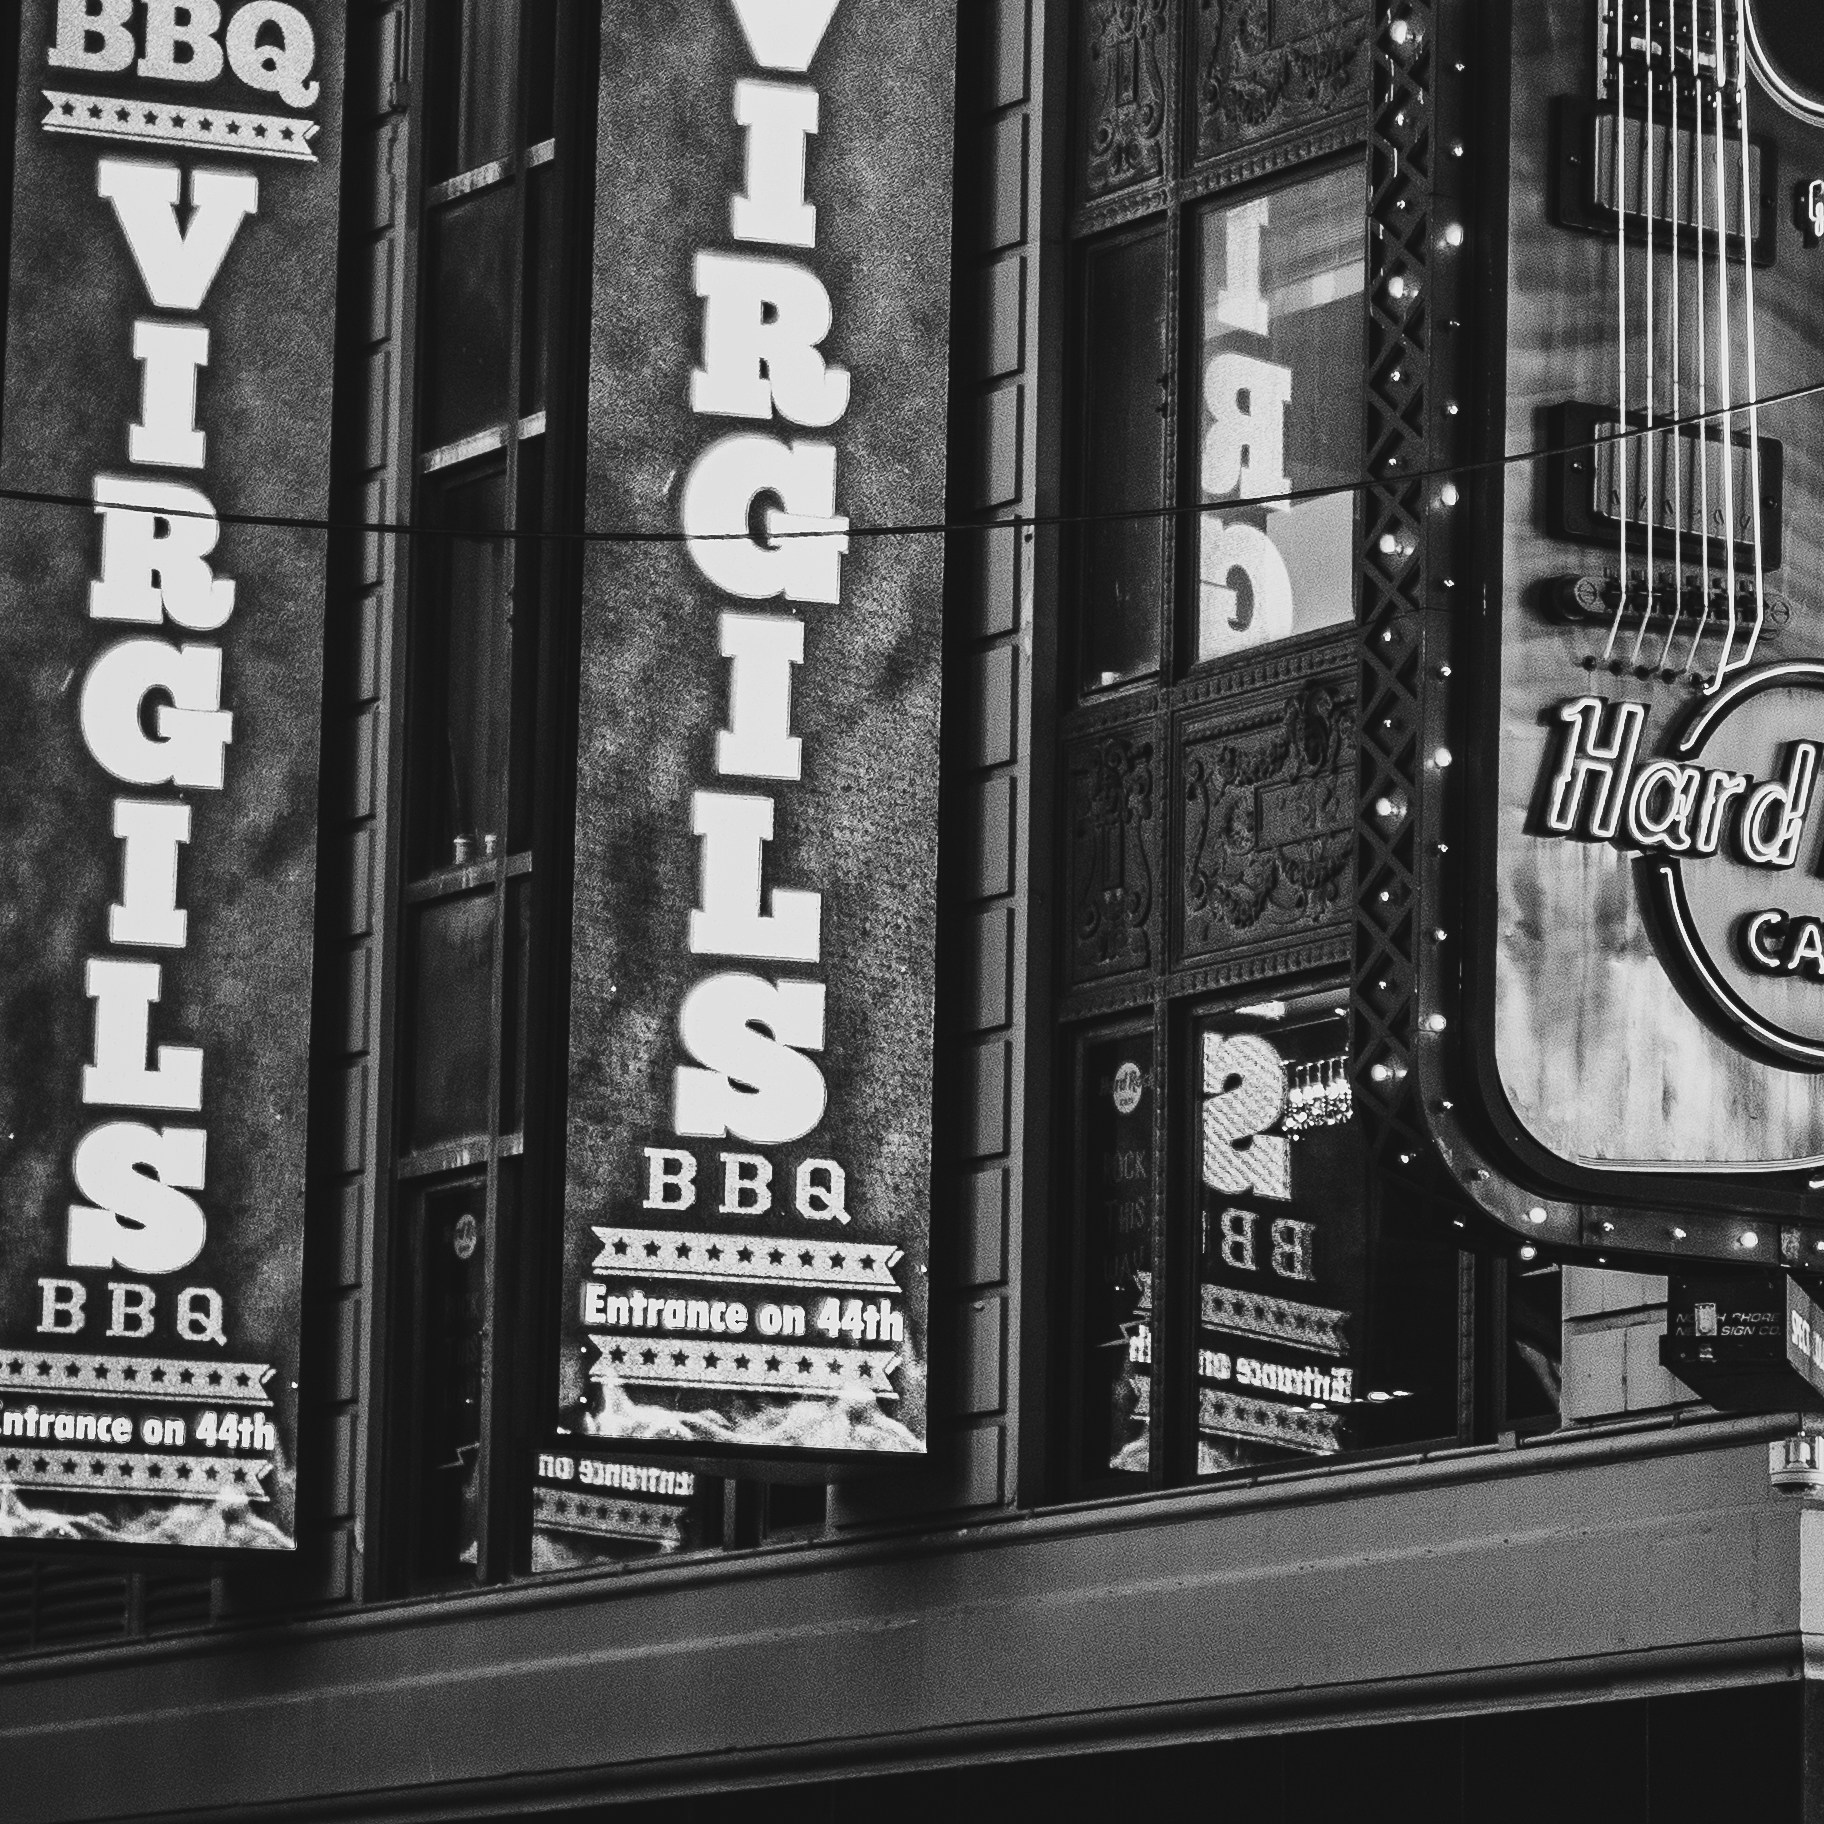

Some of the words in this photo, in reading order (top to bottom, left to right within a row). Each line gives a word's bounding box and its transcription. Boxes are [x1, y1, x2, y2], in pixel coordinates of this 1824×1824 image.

[66, 157, 259, 1275] VIRGILS
[1540, 694, 1818, 868] Hard
[642, 1147, 852, 1225] BBQ
[36, 1277, 228, 1346] BBQ
[582, 1282, 749, 1334] Entrance
[760, 1304, 806, 1336] on
[816, 1296, 904, 1342] 44th
[0, 1397, 133, 1445] ntrance
[141, 1415, 186, 1447] on
[196, 1411, 276, 1452] 44th
